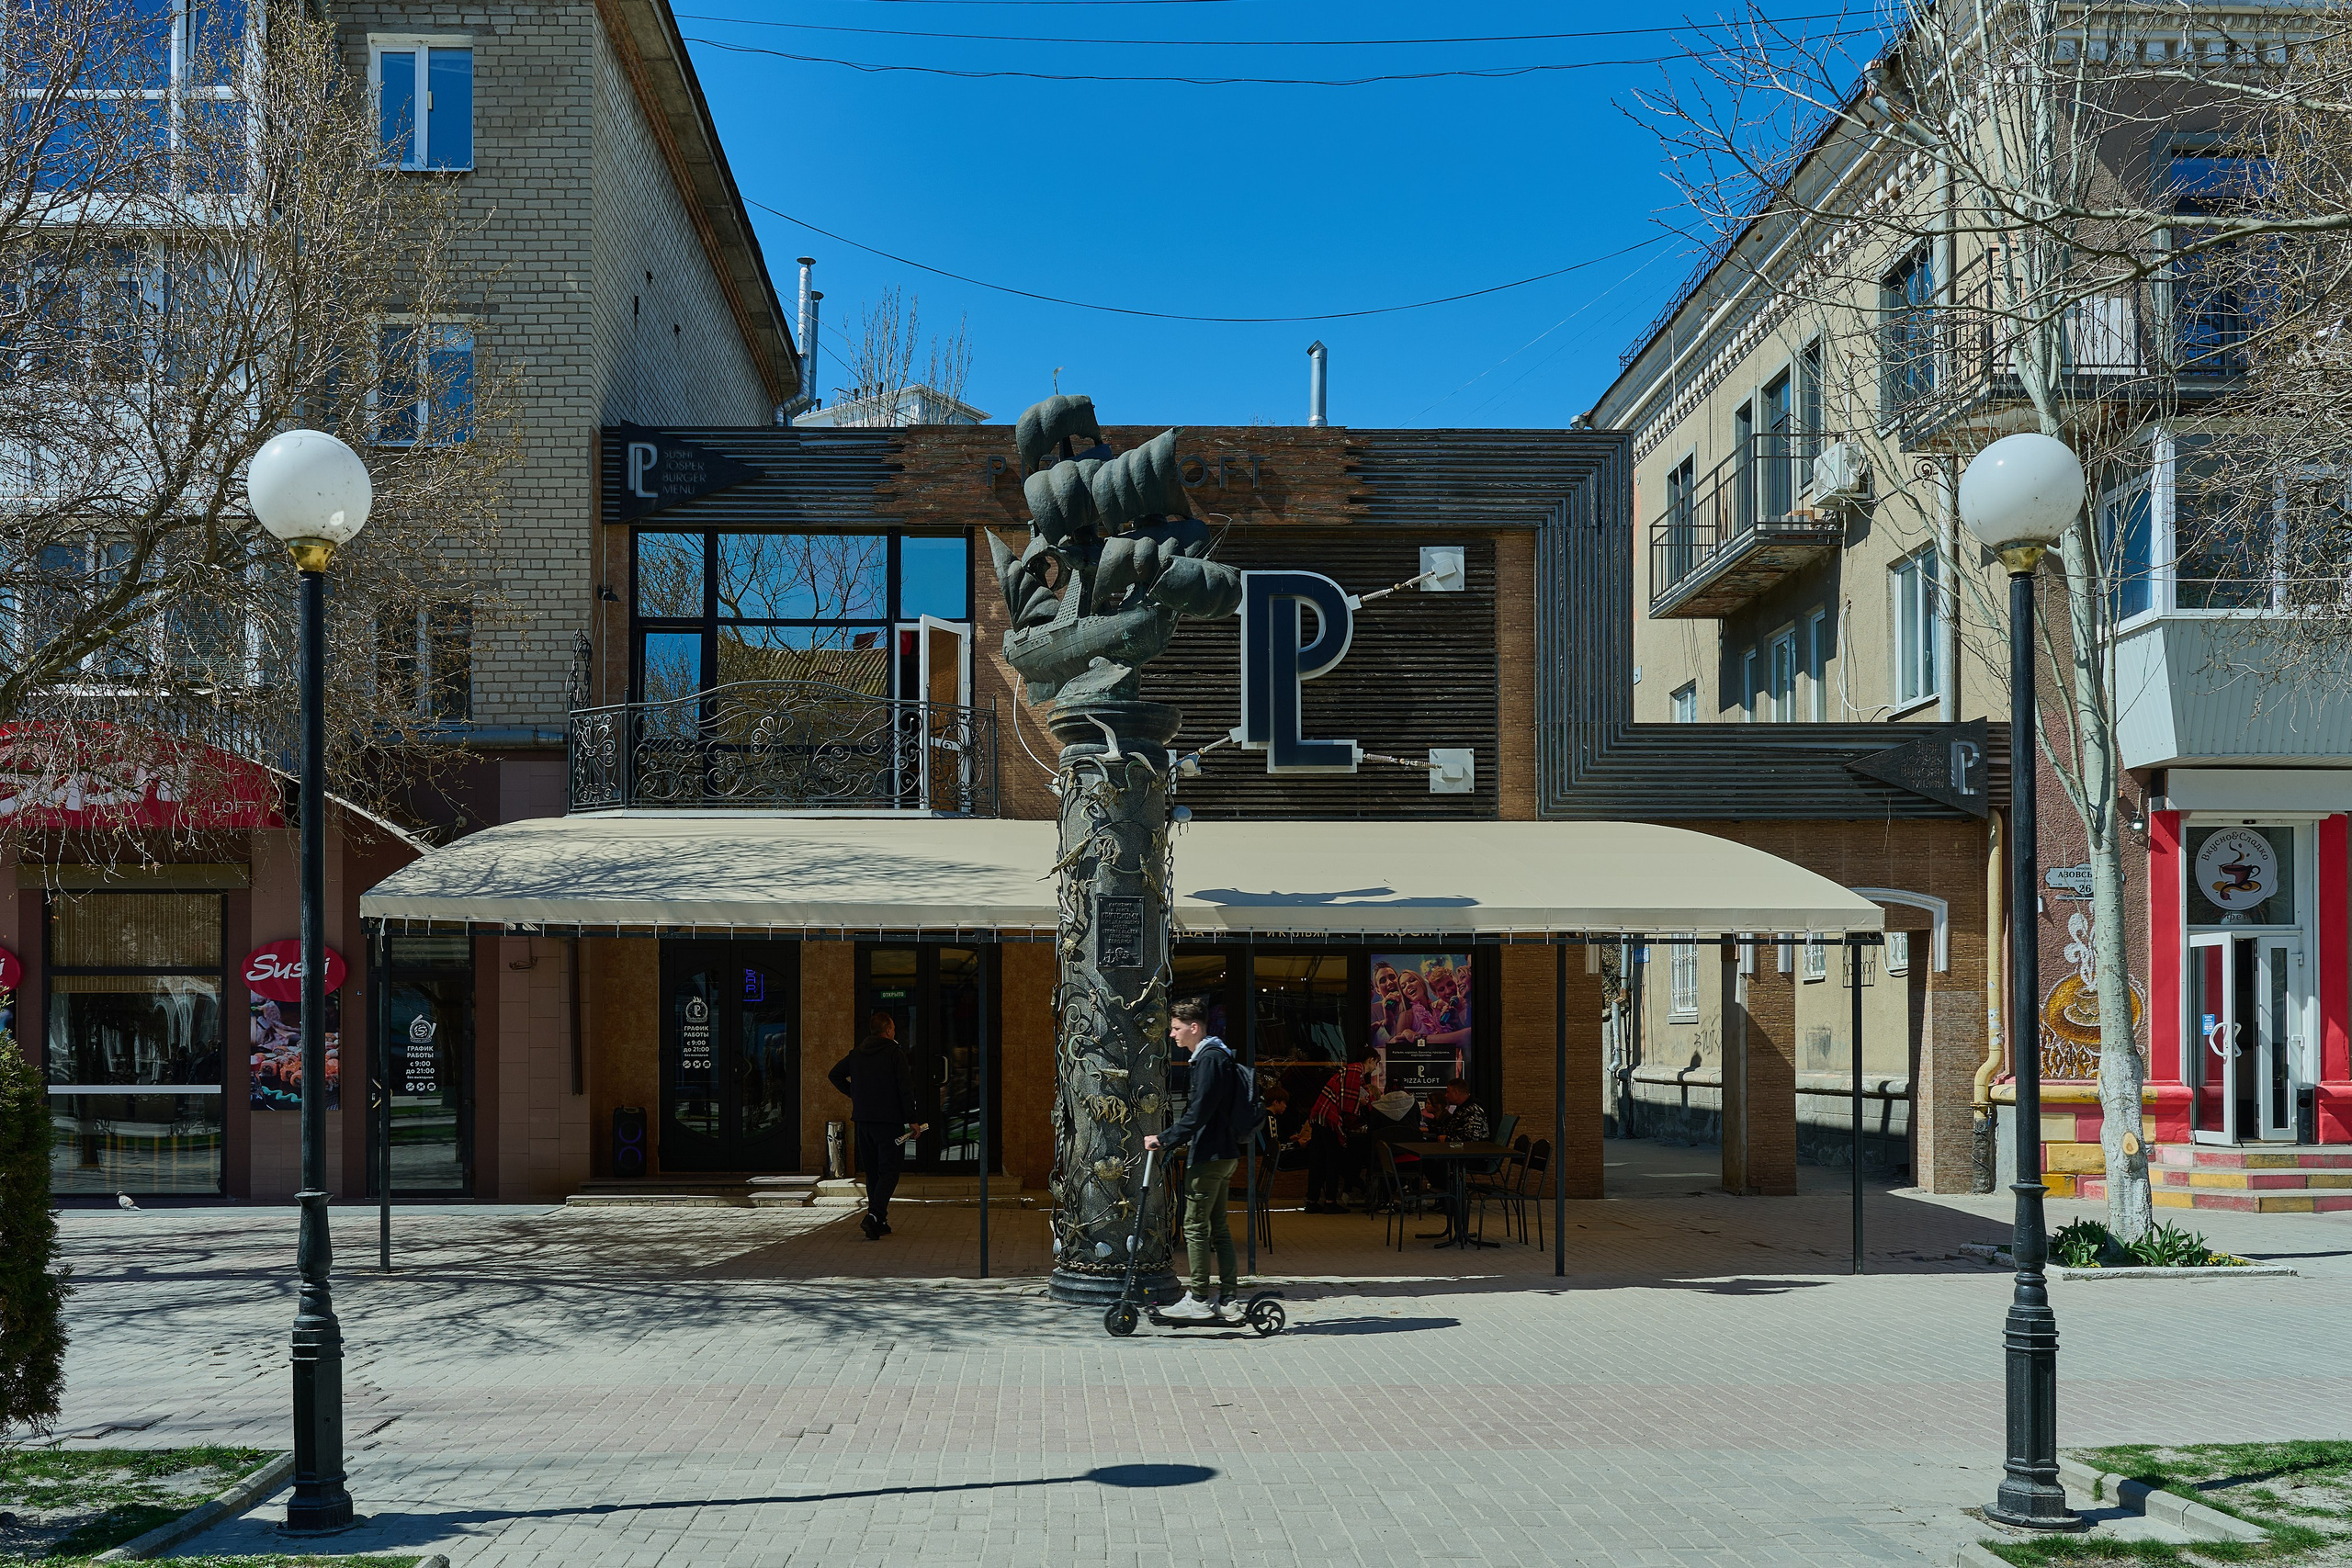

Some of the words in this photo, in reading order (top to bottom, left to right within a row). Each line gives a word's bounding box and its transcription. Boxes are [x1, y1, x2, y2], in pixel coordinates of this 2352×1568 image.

[662, 450, 693, 459] SUSHI
[663, 461, 705, 471] JOSPER
[662, 472, 707, 483] BURGER
[662, 484, 695, 495] MENU
[1914, 742, 1945, 754] SUSHI
[1900, 766, 1945, 777] BURGER
[213, 801, 255, 814] LOFT
[2078, 884, 2092, 893] 26
[245, 953, 330, 983] Susi
